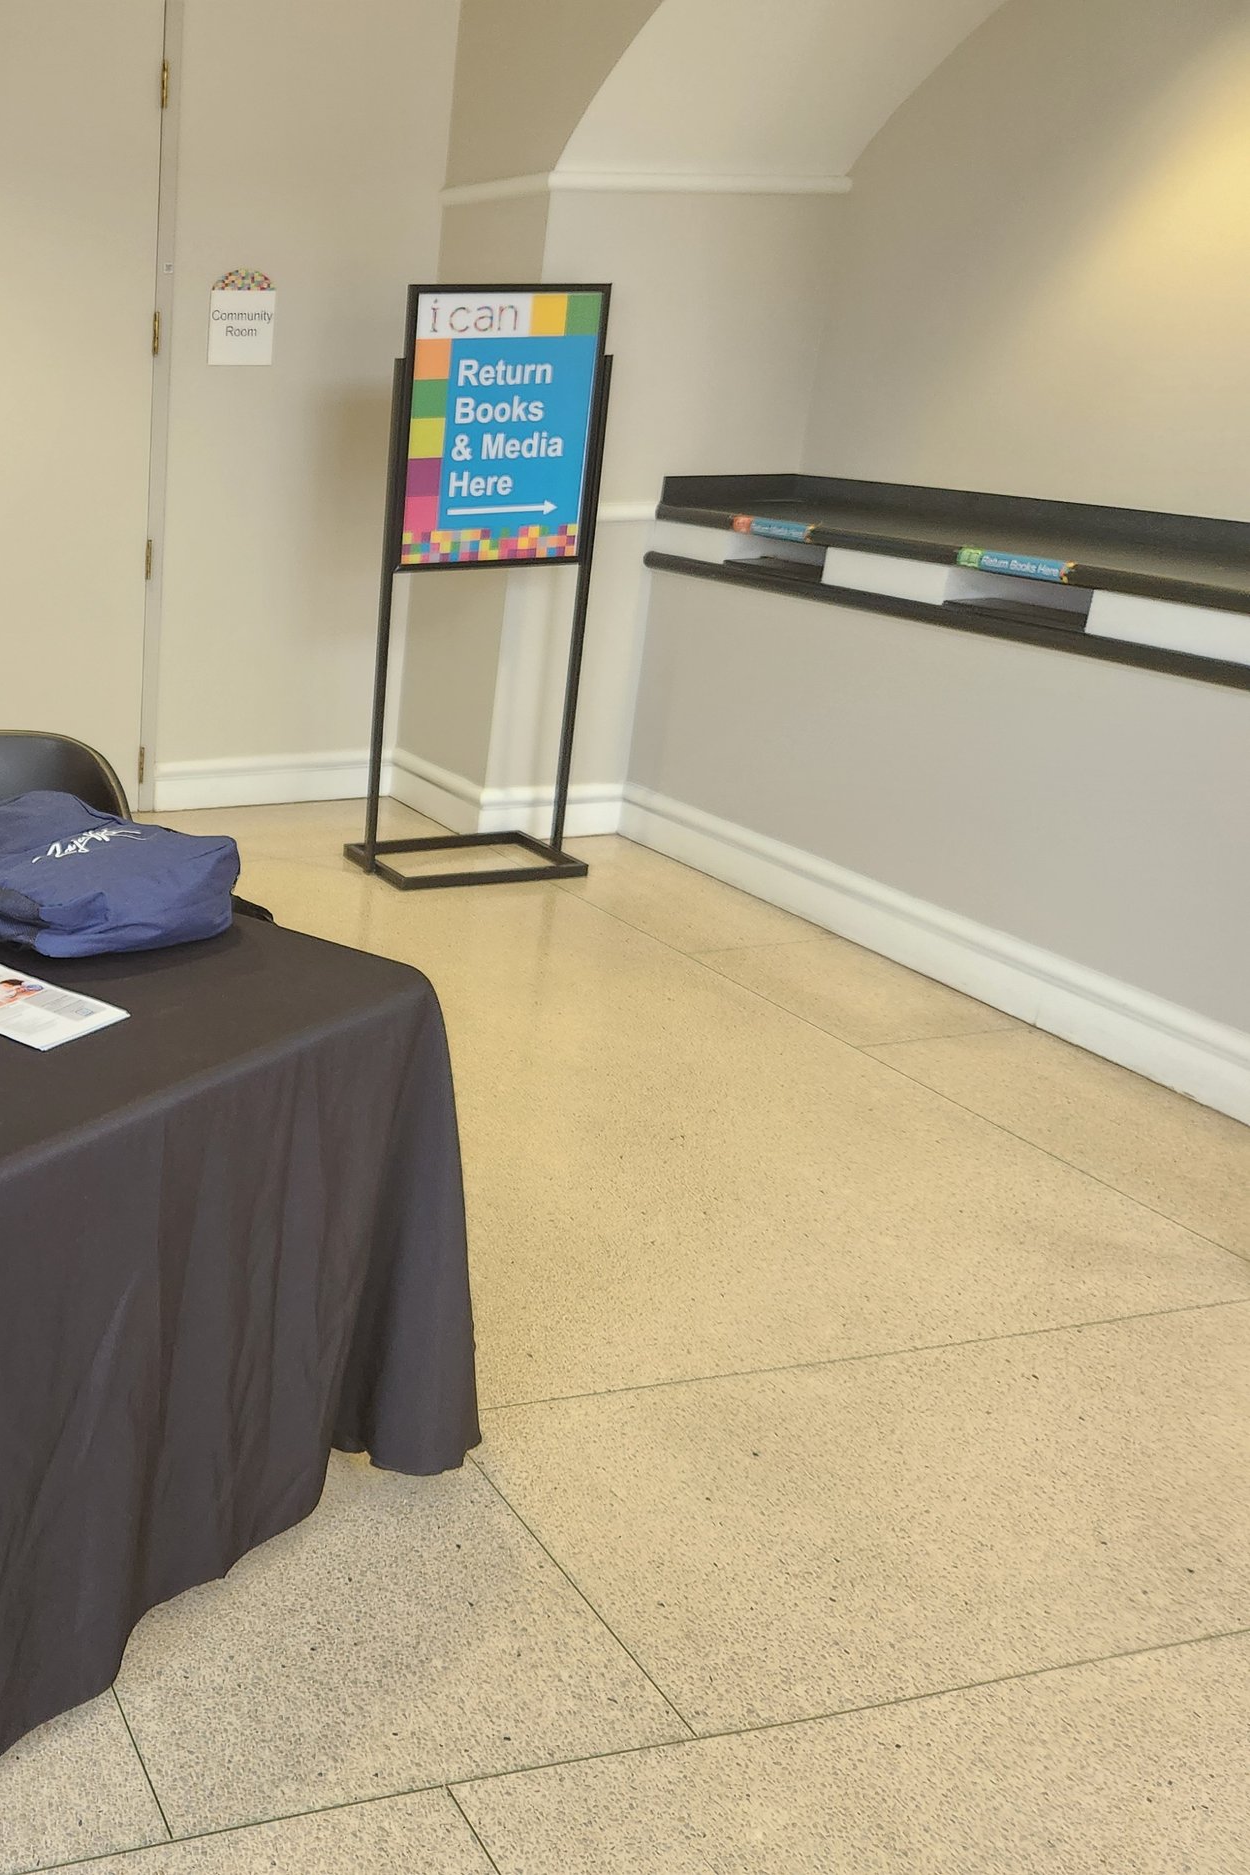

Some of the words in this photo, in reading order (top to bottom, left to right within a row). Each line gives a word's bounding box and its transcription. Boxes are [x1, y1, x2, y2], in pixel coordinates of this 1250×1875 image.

[211, 309, 273, 324] Community
[429, 298, 440, 333] i
[449, 303, 519, 334] can
[225, 325, 257, 337] Room
[456, 358, 552, 387] Return
[454, 395, 544, 425] Books
[450, 433, 473, 462] &
[481, 430, 563, 461] Media
[448, 470, 513, 498] Here
[981, 555, 1008, 569] Return
[1009, 559, 1037, 574] Books
[1037, 563, 1059, 577] Here
